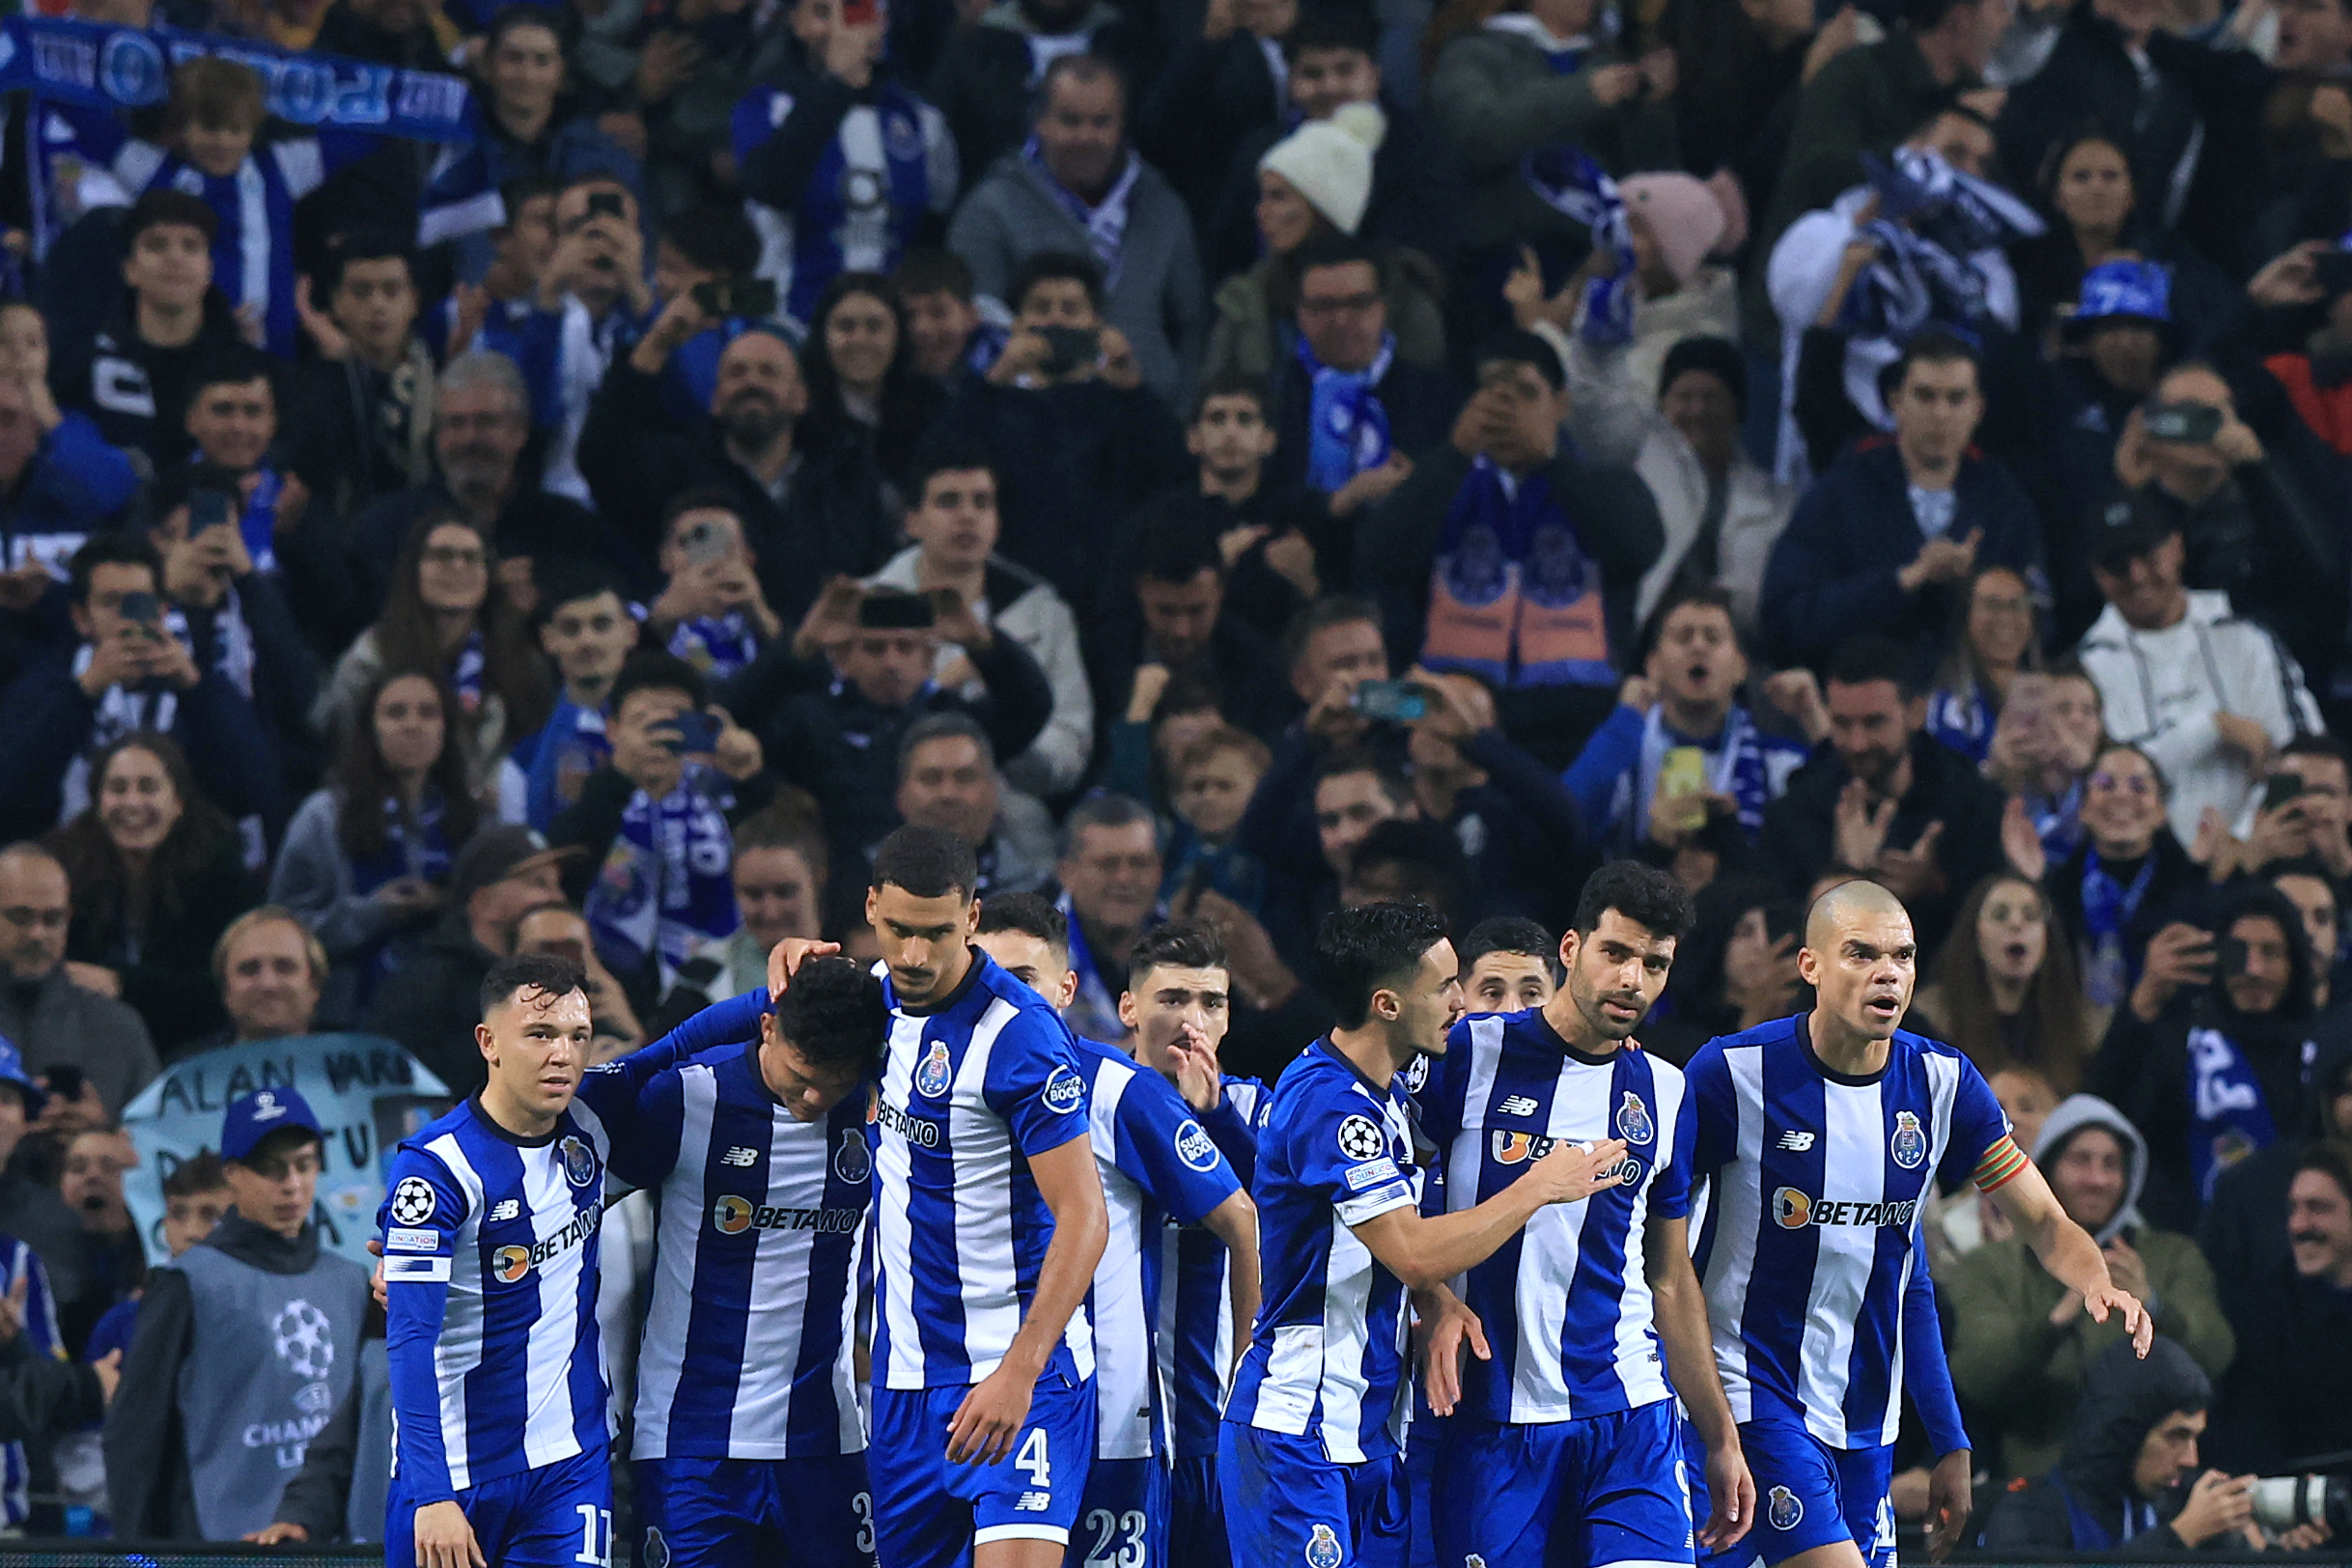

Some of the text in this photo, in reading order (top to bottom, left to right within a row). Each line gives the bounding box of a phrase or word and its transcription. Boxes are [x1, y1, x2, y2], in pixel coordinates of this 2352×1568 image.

[1050, 1085, 1081, 1102] BOCK
[877, 1099, 938, 1147] BETANO
[752, 1205, 858, 1234] BETANO
[242, 1414, 329, 1448] CHAM
[1015, 1427, 1050, 1488] 4
[1083, 1508, 1147, 1568] 23
